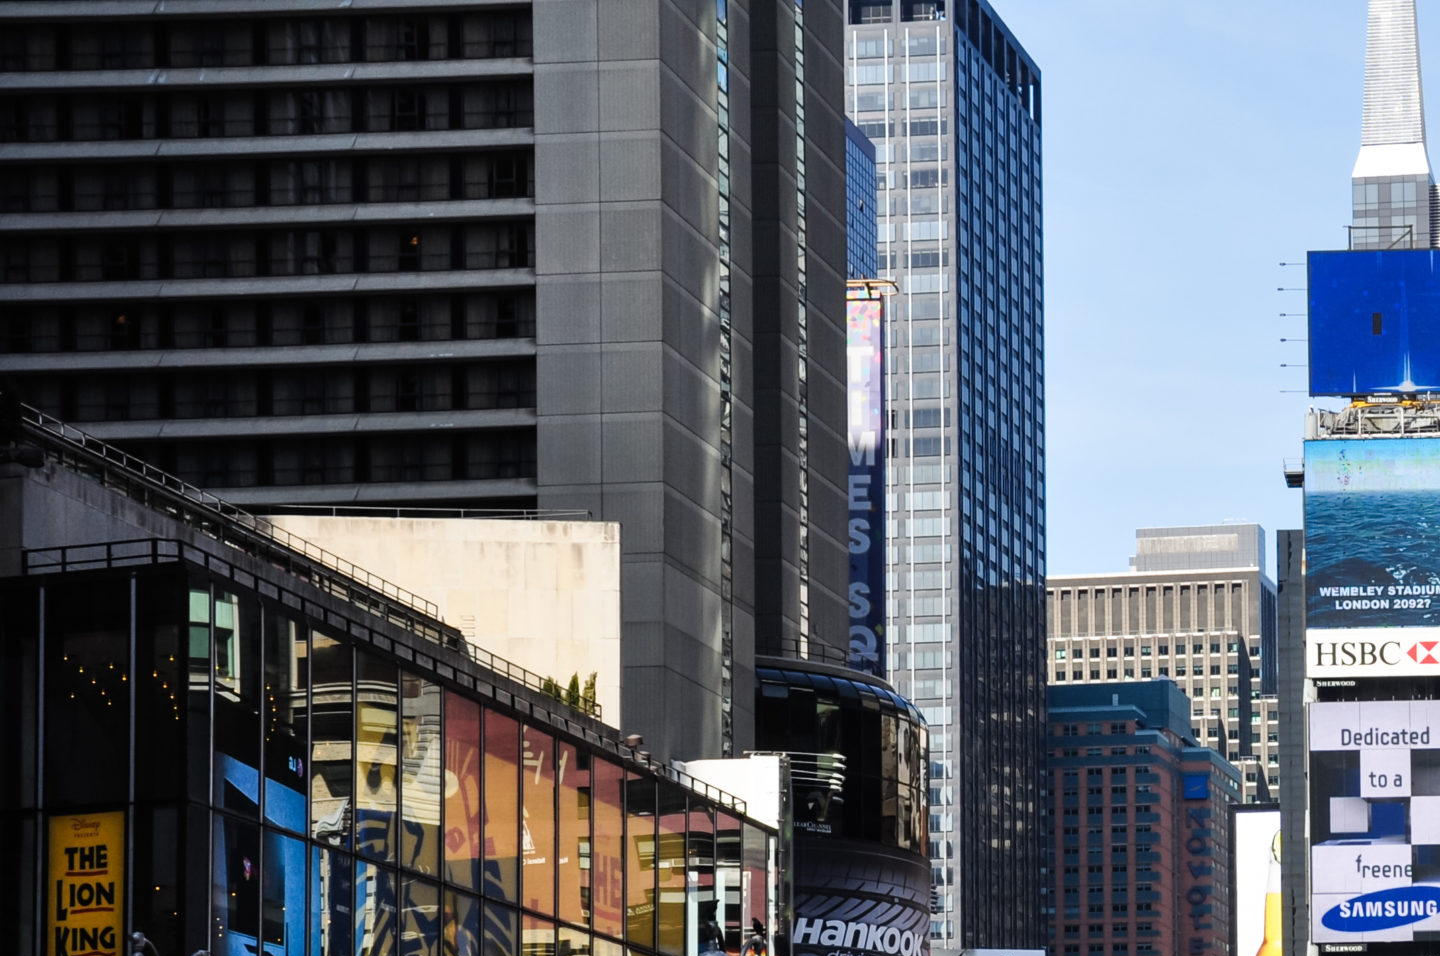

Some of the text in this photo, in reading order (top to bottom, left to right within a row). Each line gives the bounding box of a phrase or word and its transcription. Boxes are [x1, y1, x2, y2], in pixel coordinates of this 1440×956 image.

[847, 345, 876, 554] TIMES
[1319, 586, 1384, 597] WEMBLEY
[1336, 599, 1431, 610] LONDON 2092?
[1315, 641, 1401, 667] HSBC
[1341, 726, 1430, 746] Dedicated
[1368, 771, 1403, 788] to a
[64, 844, 108, 871] THE
[56, 879, 115, 922] LION
[1339, 900, 1438, 918] SAMSUNG
